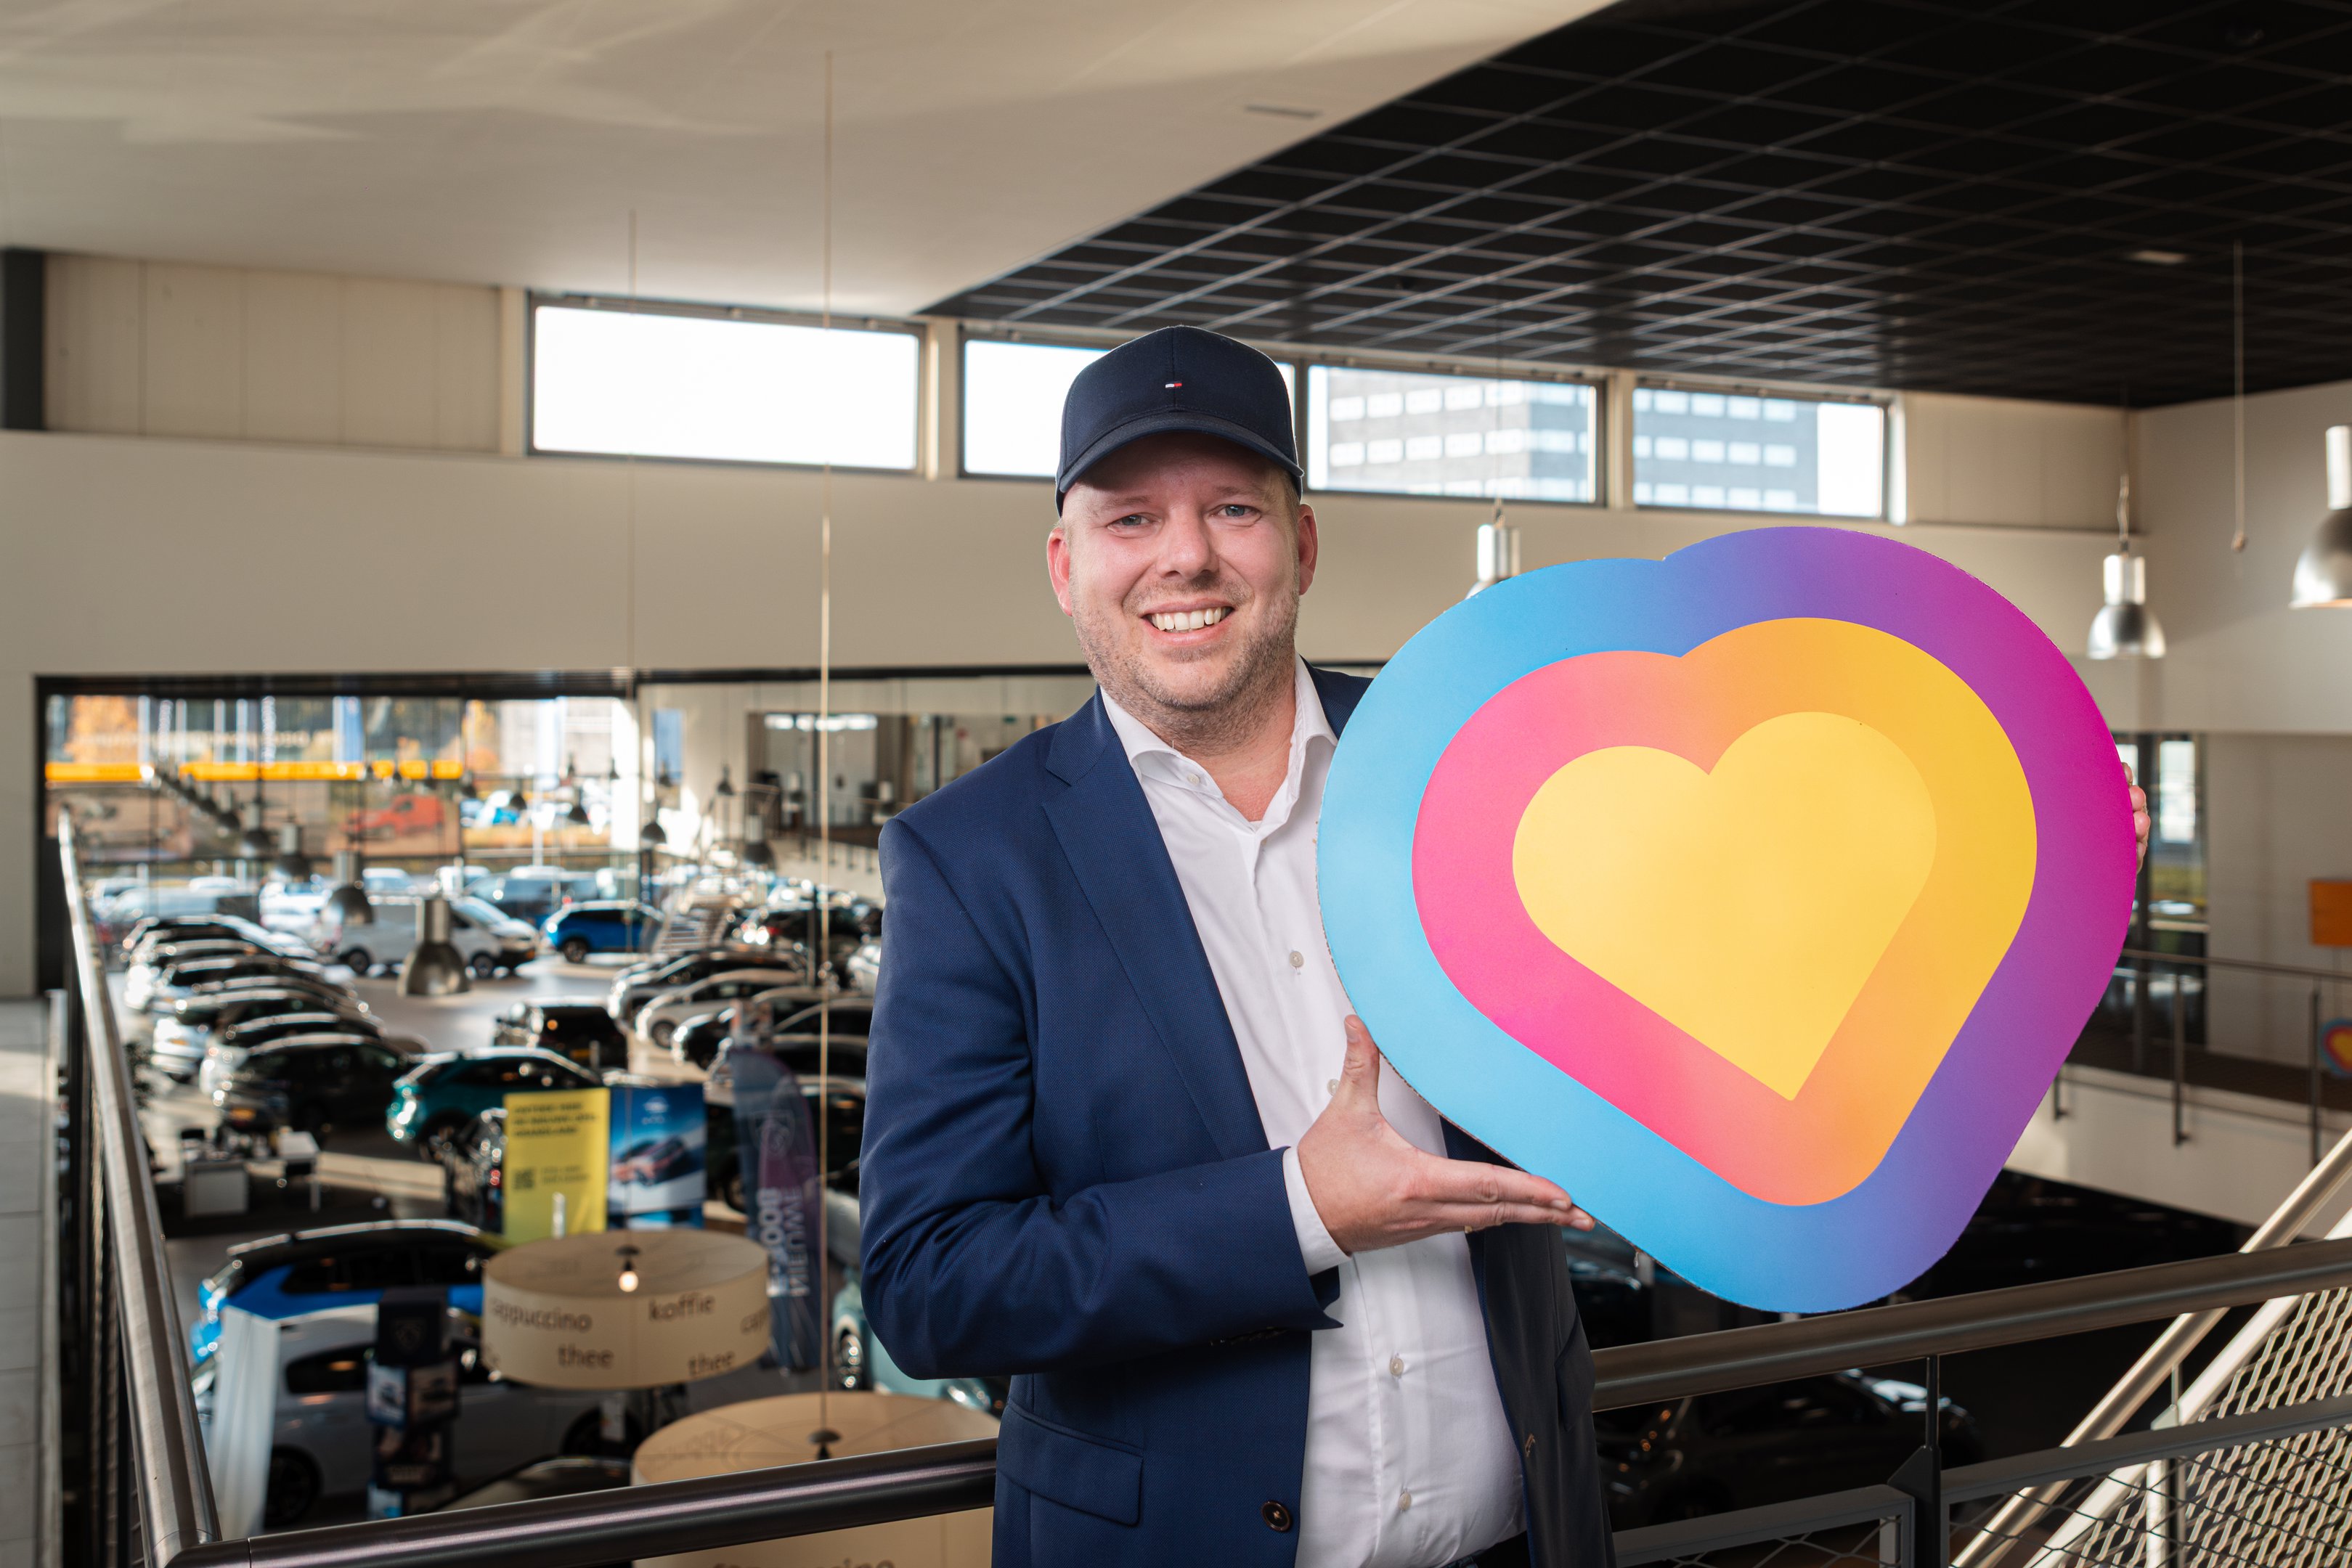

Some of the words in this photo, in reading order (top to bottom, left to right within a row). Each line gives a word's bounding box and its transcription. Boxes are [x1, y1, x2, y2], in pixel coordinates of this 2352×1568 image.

[648, 1292, 715, 1322] koffie
[558, 1342, 614, 1369] thee
[688, 1349, 736, 1377] thee
